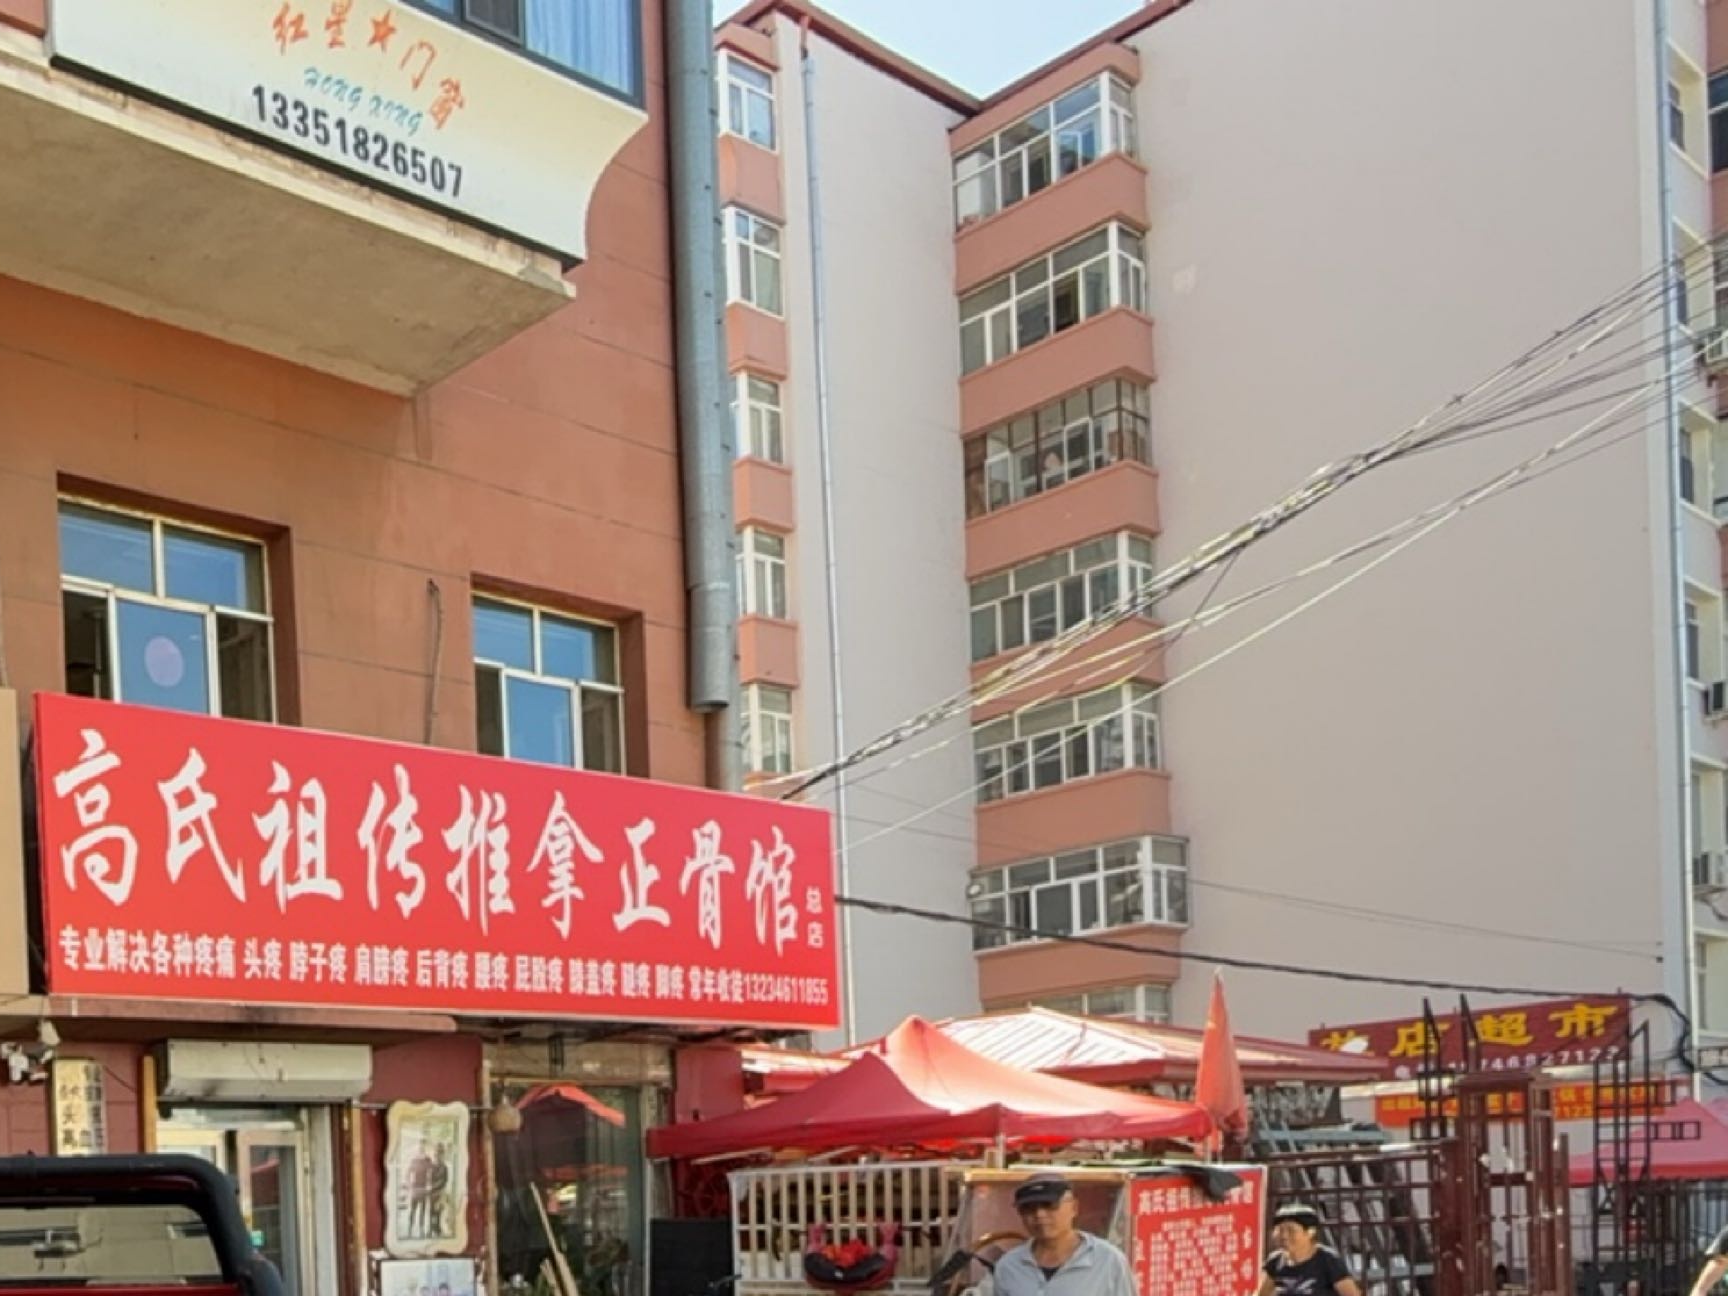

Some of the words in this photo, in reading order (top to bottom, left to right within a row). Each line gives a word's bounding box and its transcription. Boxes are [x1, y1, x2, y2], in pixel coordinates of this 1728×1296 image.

[251, 84, 463, 198] 13351826507
[53, 727, 801, 958] 高氏祖传推拿正骨馆
[58, 923, 237, 980] 专业解决各种疼痛
[242, 936, 283, 982] 头疼
[288, 938, 348, 985] 脖子疼
[415, 947, 469, 990] 后背疼
[805, 886, 825, 950] 总店
